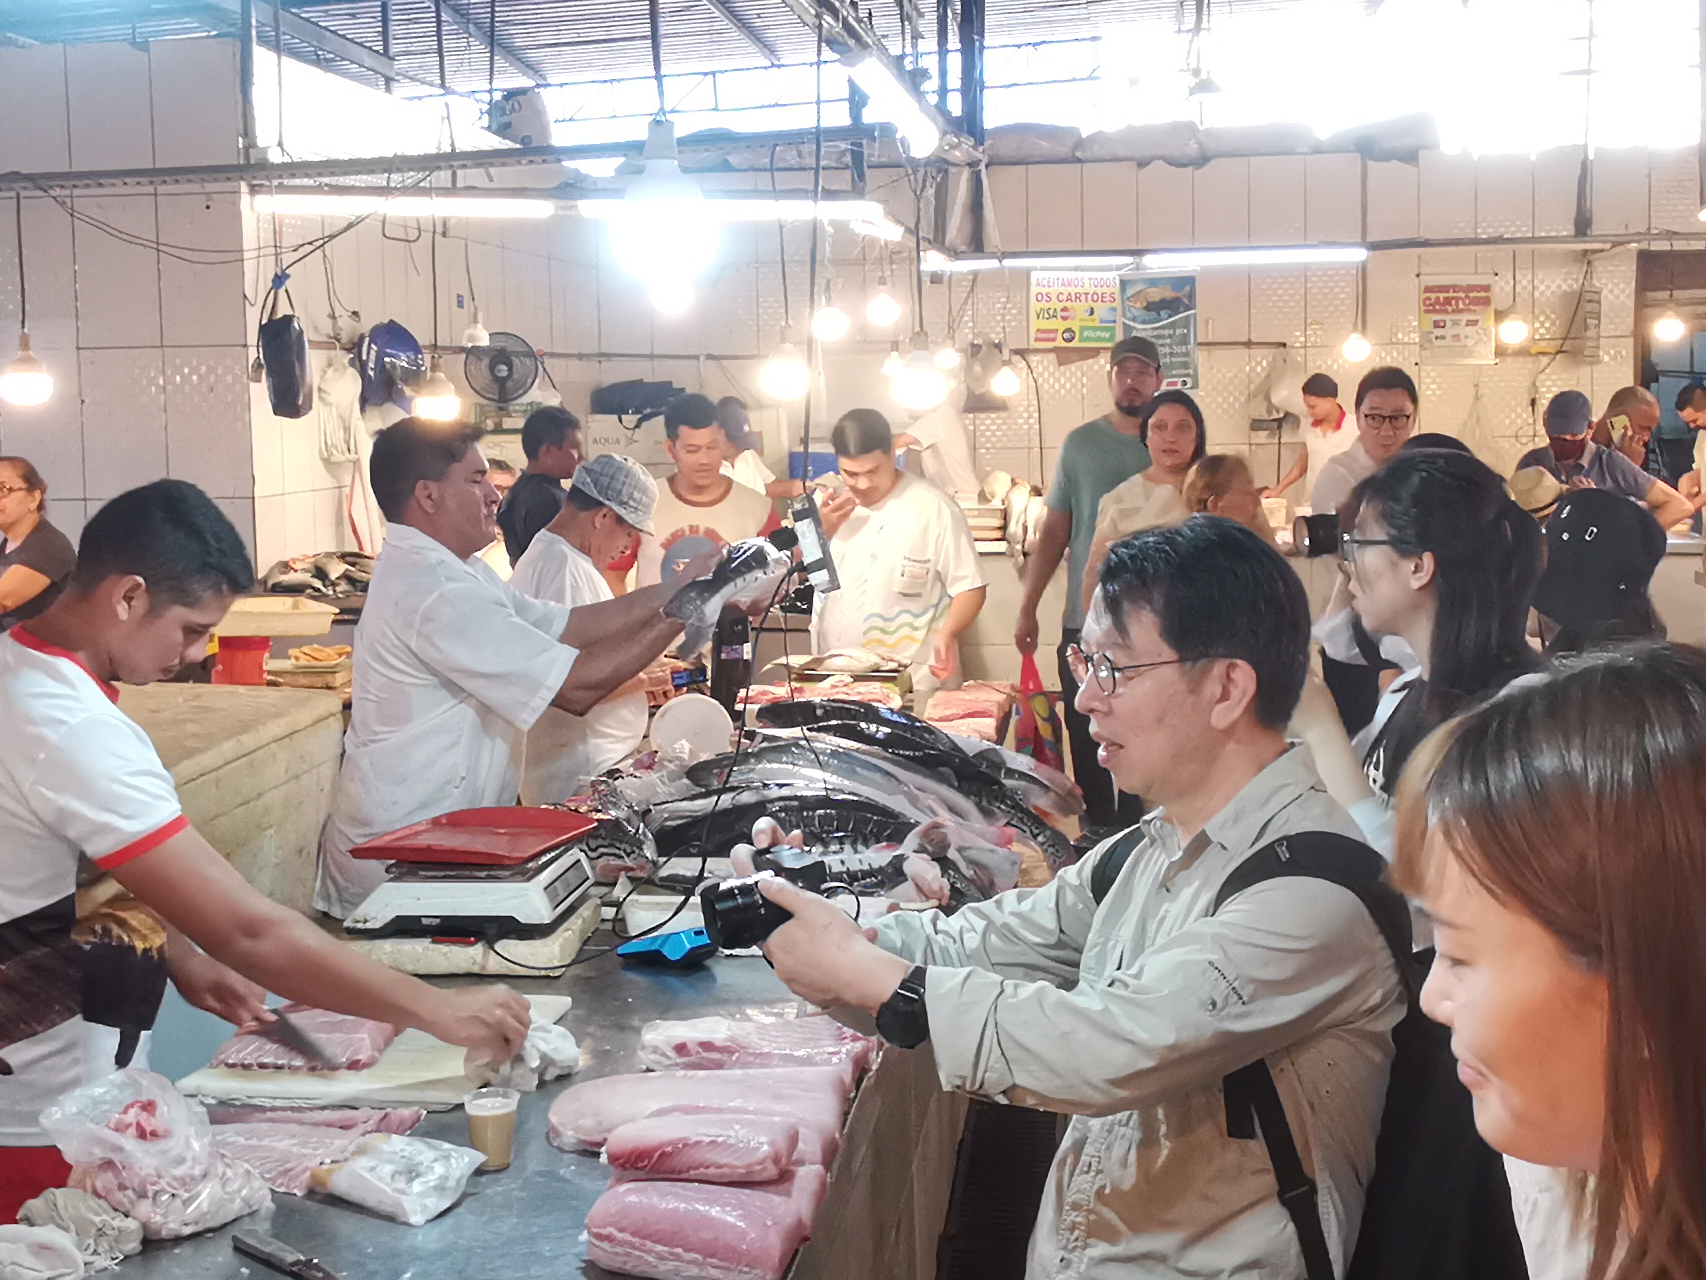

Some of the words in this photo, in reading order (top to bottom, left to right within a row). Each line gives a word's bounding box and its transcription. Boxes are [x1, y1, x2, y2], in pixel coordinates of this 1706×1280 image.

[1035, 277, 1085, 289] ACEITAMOS
[1088, 276, 1117, 288] TODOS
[1035, 292, 1052, 303] OS
[1056, 290, 1116, 303] CARTÕES
[1035, 307, 1059, 320] VISA
[593, 436, 621, 447] AQUA
